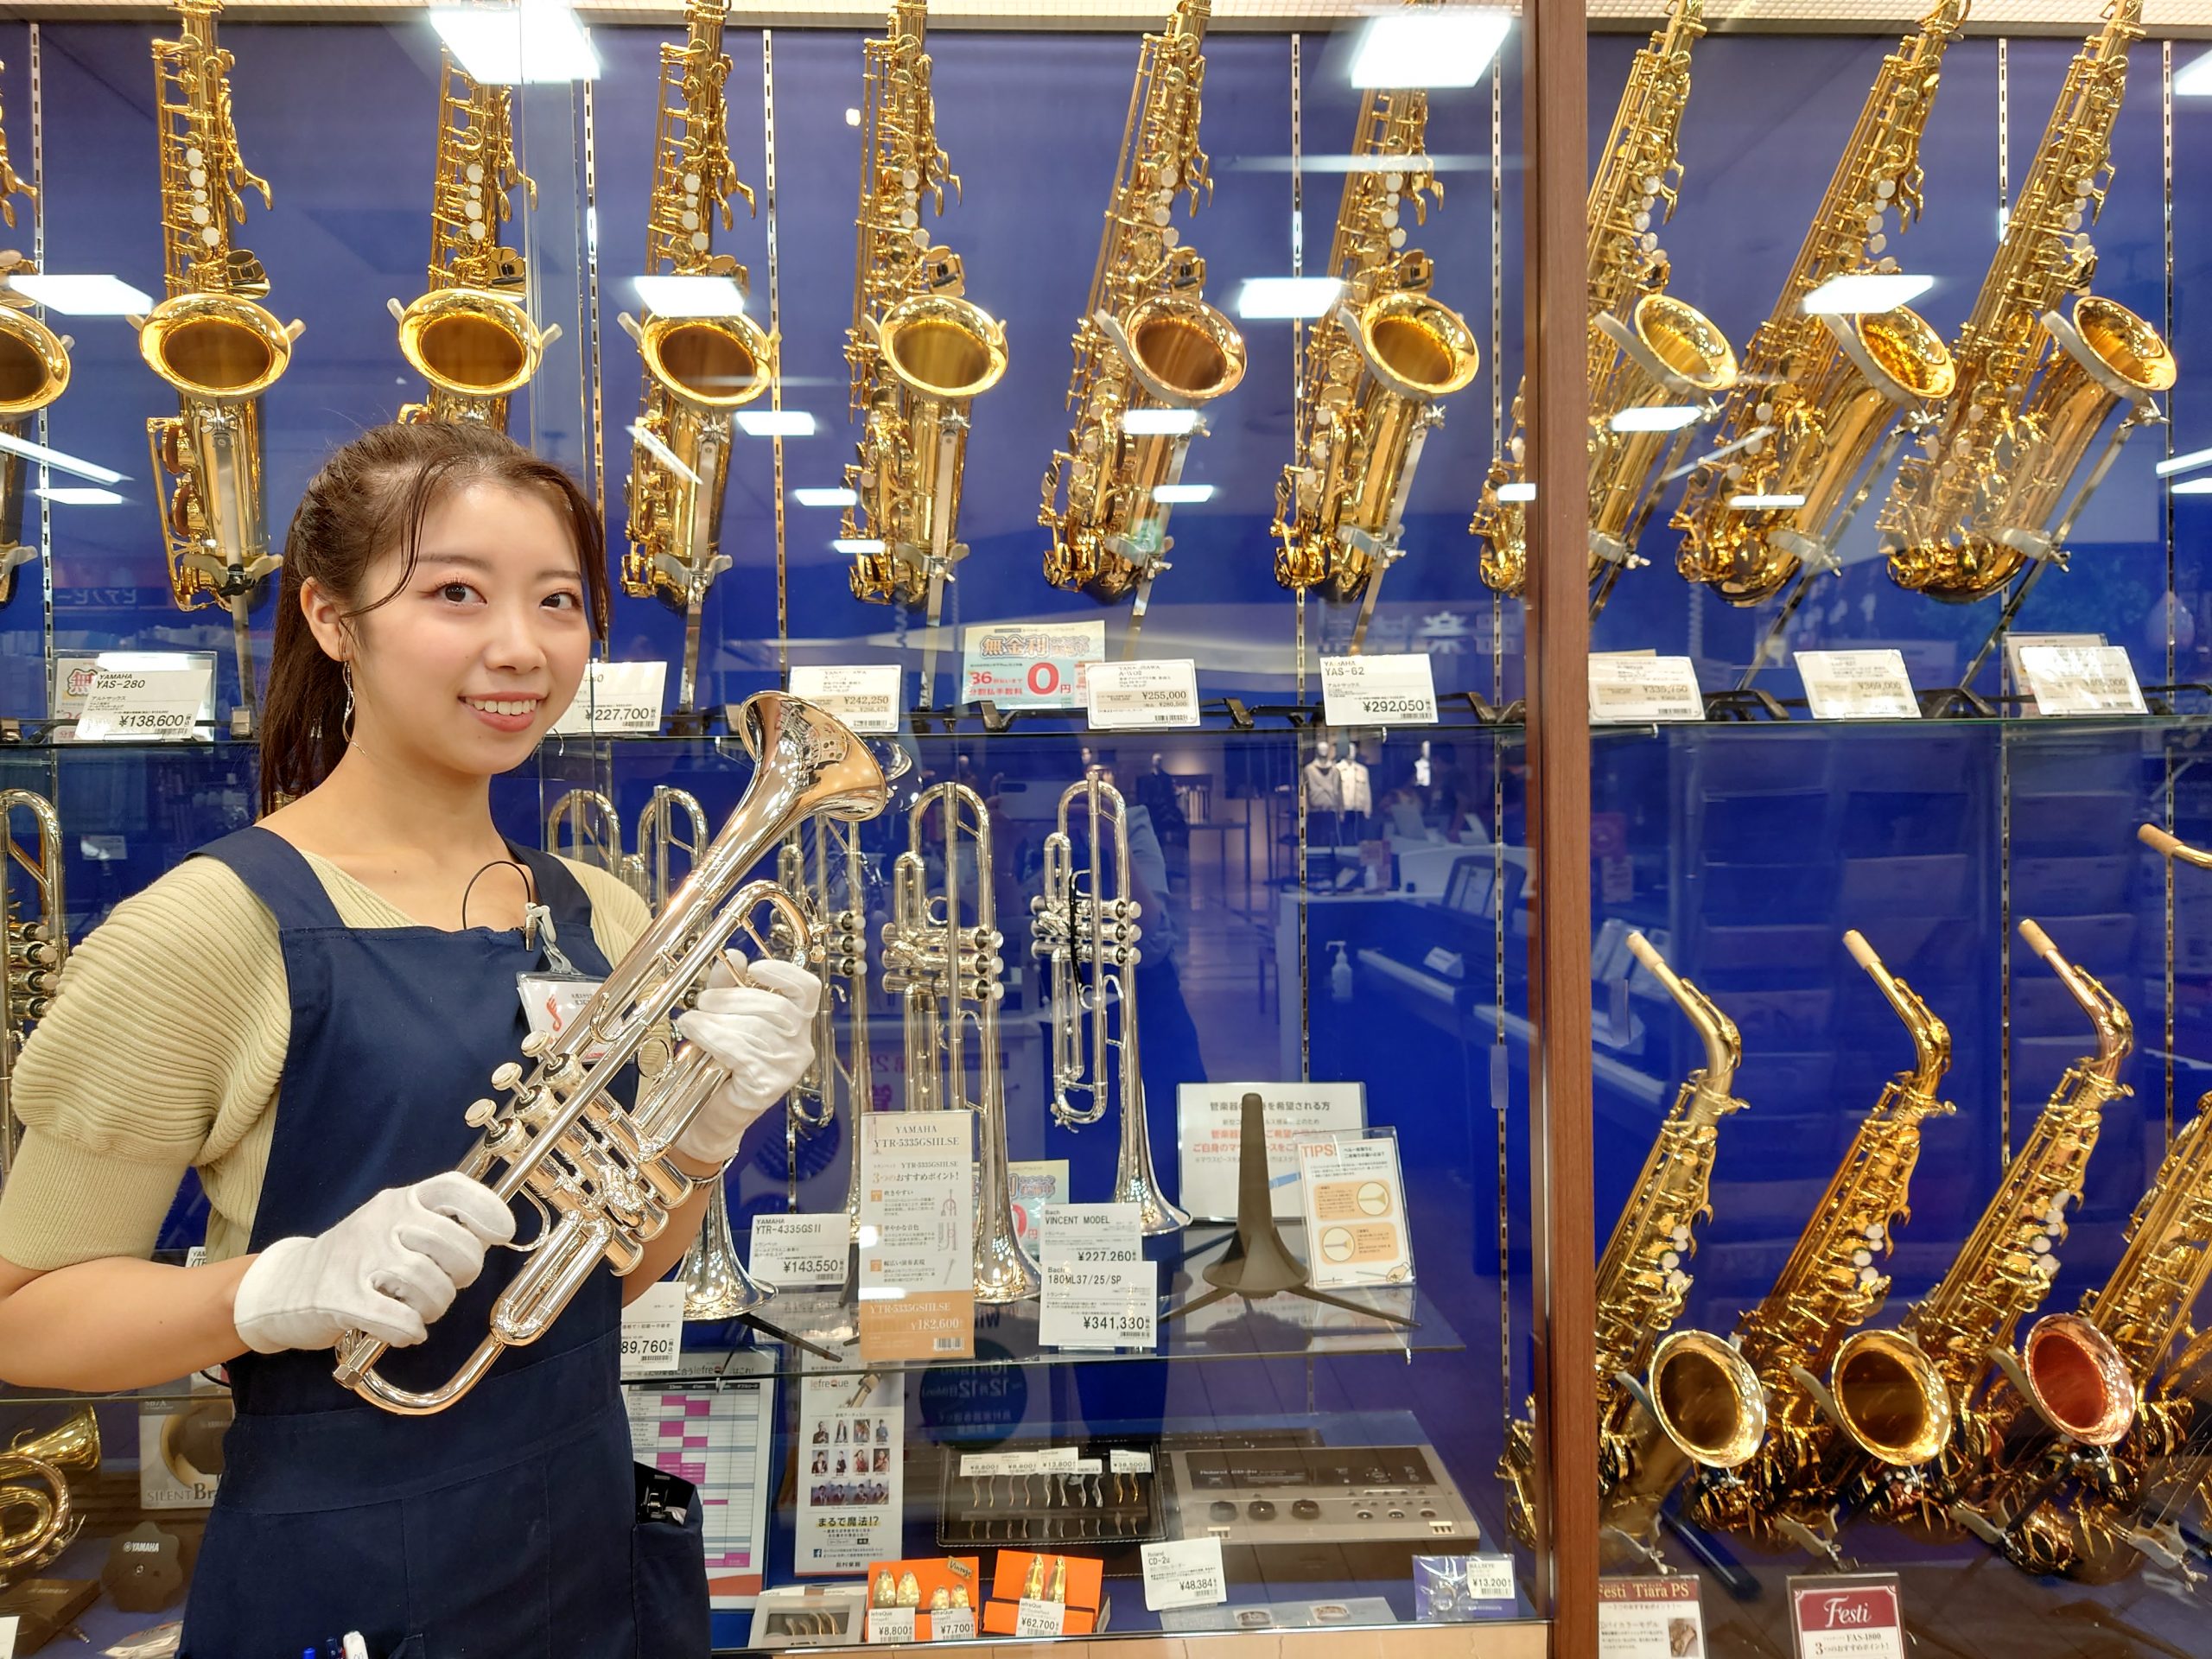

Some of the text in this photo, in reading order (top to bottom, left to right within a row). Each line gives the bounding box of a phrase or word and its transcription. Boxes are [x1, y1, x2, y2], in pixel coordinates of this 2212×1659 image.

[1325, 667, 1365, 676] YAS-62
[97, 680, 145, 689] YAS-280
[1141, 691, 1186, 700] ¥255,000
[1363, 700, 1425, 712] ¥292,050
[119, 715, 184, 727] ¥138,600
[896, 1125, 938, 1134] YAMAHA
[1045, 1216, 1078, 1224] VINCENT
[783, 1260, 838, 1273] ¥143,550
[1084, 1317, 1144, 1330] ¥341,330
[148, 1491, 193, 1502] SILENT
[818, 1516, 879, 1527] まるで魔法!?
[131, 1542, 159, 1553] YAMAHA
[1179, 1579, 1213, 1591] ¥48,384
[1632, 1583, 1668, 1598] Tiara
[1671, 1582, 1689, 1598] PS
[1823, 1595, 1872, 1628] Festi
[941, 1624, 970, 1634] ¥7,700
[1021, 1618, 1055, 1630] ¥62,700
[879, 1626, 908, 1635] ¥8,800
